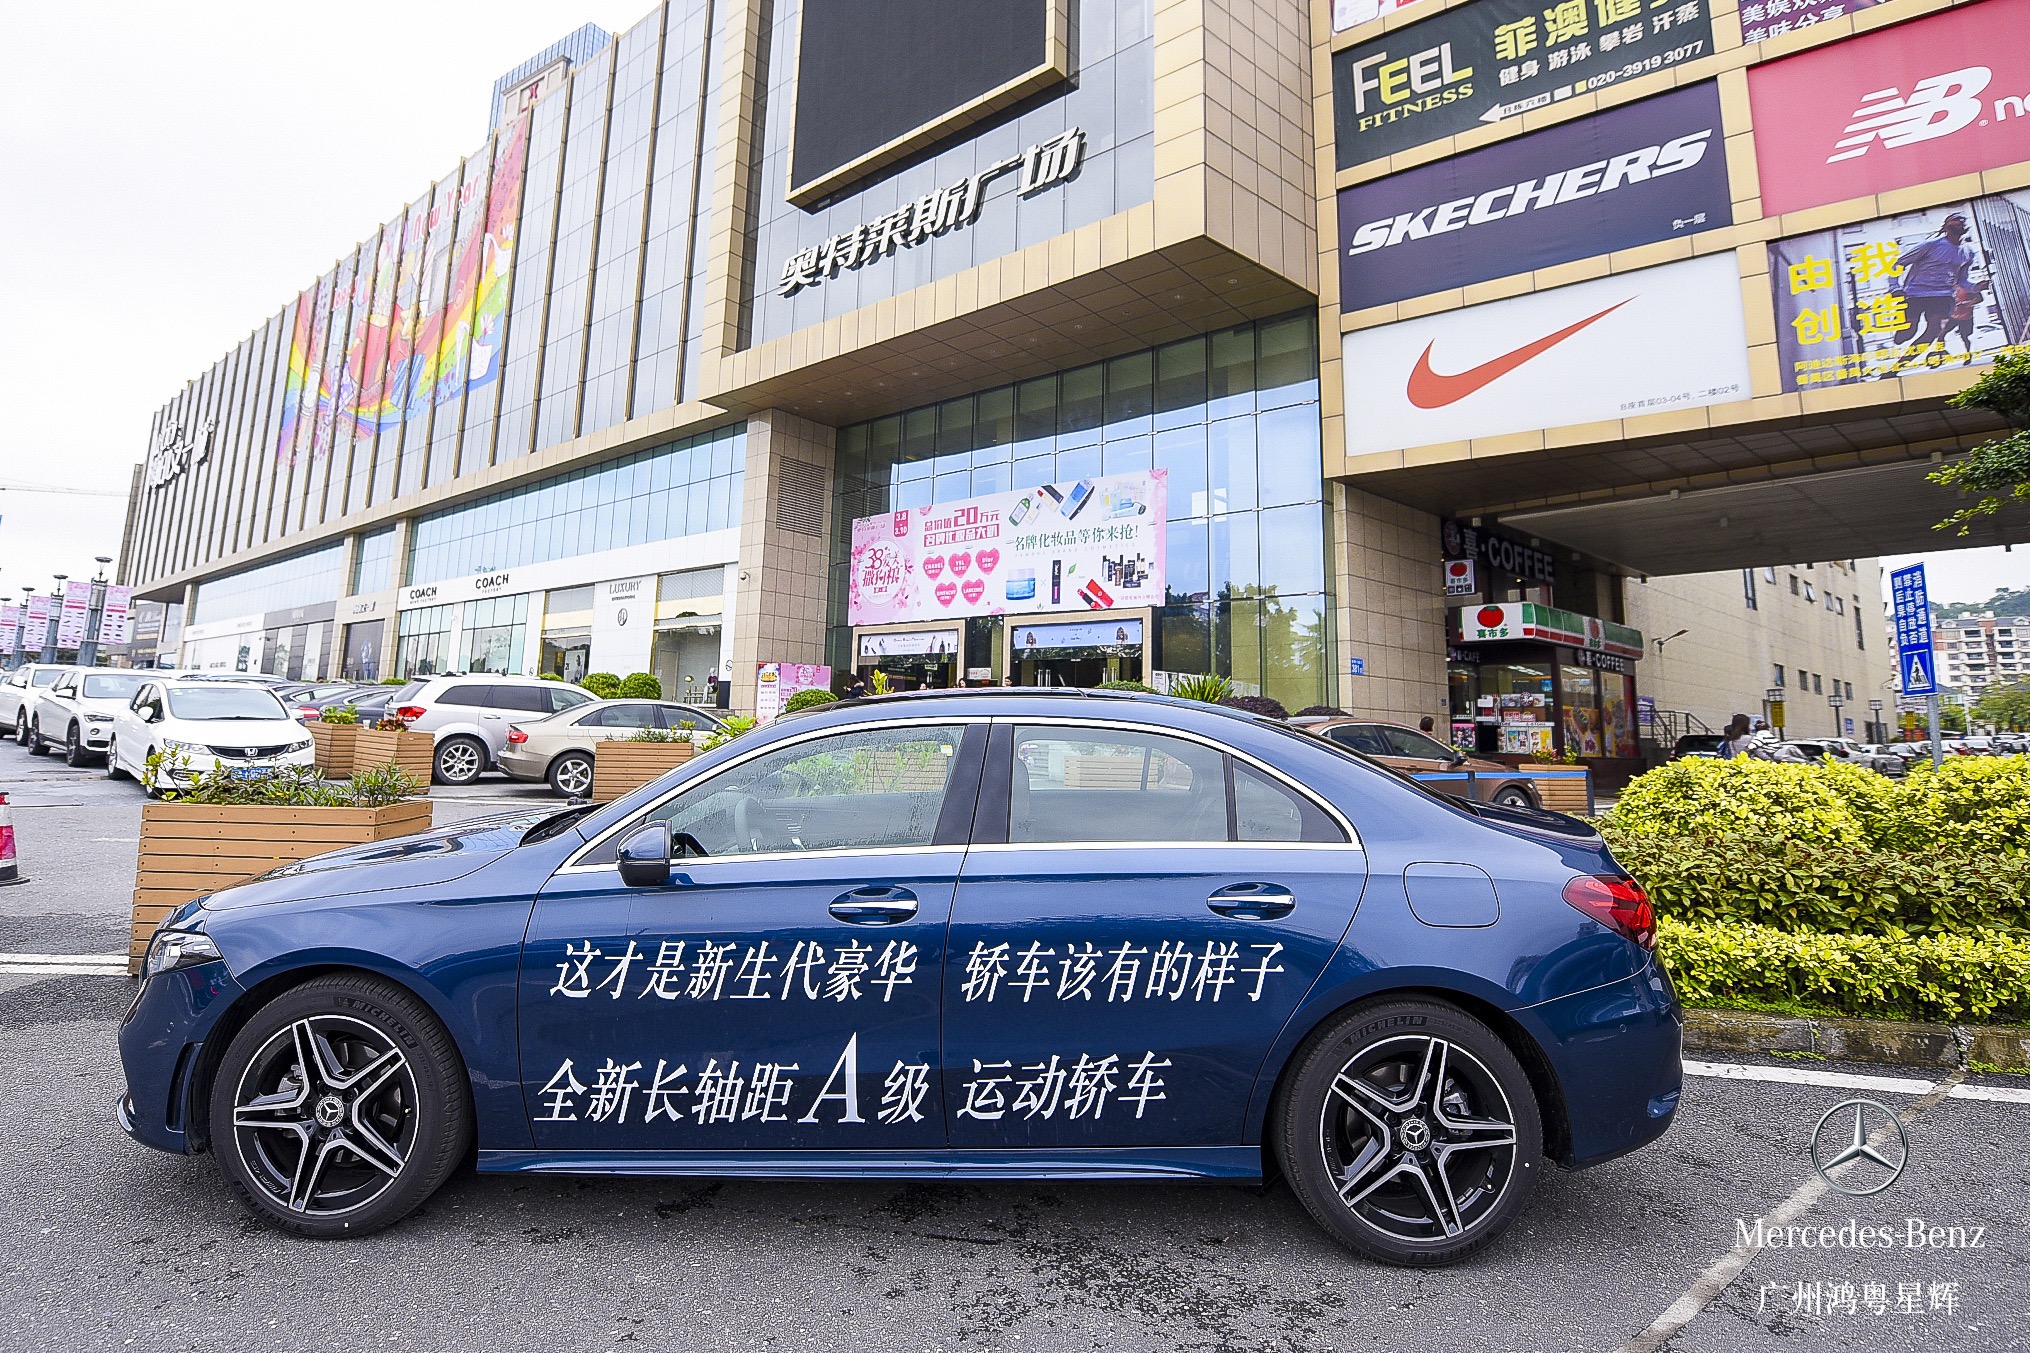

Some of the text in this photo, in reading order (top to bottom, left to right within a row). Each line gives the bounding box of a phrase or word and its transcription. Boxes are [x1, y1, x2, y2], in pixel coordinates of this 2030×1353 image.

[1494, 0, 1669, 60] 菲澳健
[1499, 1, 1699, 87] 健身 游泳 攀岩 汗蒸
[1744, 4, 1845, 45] 美味分享
[1353, 42, 1473, 114] FEEL
[1588, 40, 1703, 90] 020-3919 3077
[1358, 83, 1473, 132] FITNESS
[777, 126, 1087, 298] 奥特莱斯广场
[1348, 129, 1713, 256] SKECHERS
[1672, 212, 1707, 231] 负一层
[896, 512, 907, 521] 3.8
[475, 574, 510, 589] COACH
[1488, 536, 1555, 583] COFFEE
[409, 586, 438, 600] COACH
[609, 580, 642, 594] LUXURY
[1476, 627, 1509, 639] 喜市多
[1595, 653, 1625, 672] COFFEE
[550, 938, 1285, 1002] 这才是新生代豪华 轿车该有的样子
[351, 1000, 416, 1047] MICHELIN
[1350, 1015, 1423, 1044] MICHELIN
[957, 1051, 1172, 1120] 运动轿车
